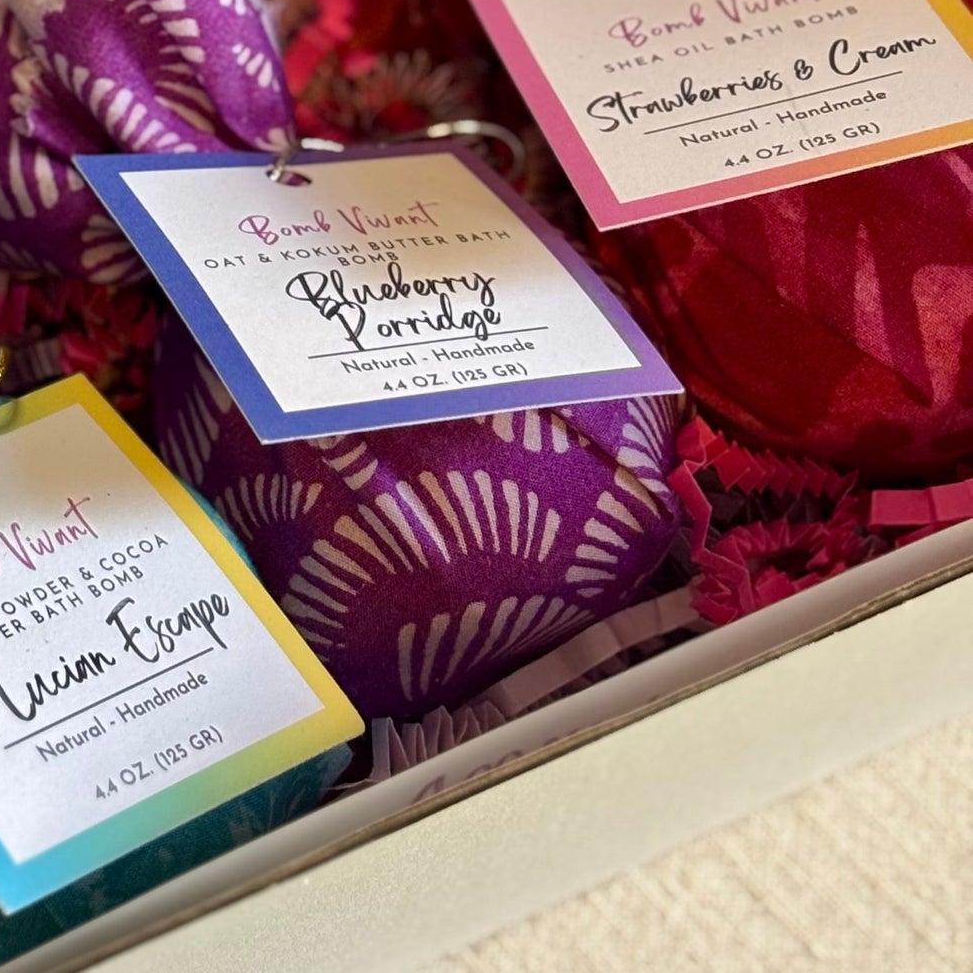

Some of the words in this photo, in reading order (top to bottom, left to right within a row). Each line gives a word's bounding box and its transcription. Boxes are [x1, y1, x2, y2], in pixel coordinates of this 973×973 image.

[604, 52, 665, 75] SHEA
[674, 41, 715, 58] OIL
[725, 24, 784, 45] BATH
[793, 4, 860, 28] BOMB
[608, 2, 707, 48] Bomb
[585, 70, 784, 133] Strawberries
[793, 59, 815, 81] &
[828, 37, 938, 77] Cream
[678, 118, 760, 148] Natural
[775, 88, 888, 126] Handmade
[724, 155, 751, 169] 4.4
[754, 144, 795, 163] OZ.
[798, 129, 839, 153] (125
[842, 121, 882, 142] GR)
[203, 255, 247, 270] OAT
[258, 252, 273, 265] &
[280, 243, 360, 262] KOKUM
[370, 235, 447, 253] BUTTER
[456, 227, 512, 244] BATH
[238, 214, 332, 247] Bomb
[340, 199, 441, 236] Vivant
[336, 250, 400, 268] BOMB
[284, 262, 497, 318] Blueberry
[324, 293, 503, 353] Porridge
[341, 352, 418, 375] Natural
[435, 337, 536, 362] Handmade
[382, 379, 409, 394] 4.4
[412, 373, 449, 390] OZ.
[450, 367, 487, 389] (125
[490, 361, 528, 382] GR)
[80, 566, 96, 583] &
[98, 533, 170, 573] COCOA
[29, 594, 85, 627] BATH
[87, 565, 146, 600] BOMB
[105, 595, 231, 665] Escape
[35, 724, 107, 764] Natural
[114, 671, 210, 724] Handmade
[94, 779, 123, 802] 4.4
[118, 762, 157, 789] OZ.
[153, 742, 191, 774] (125
[187, 725, 225, 754] GR)
